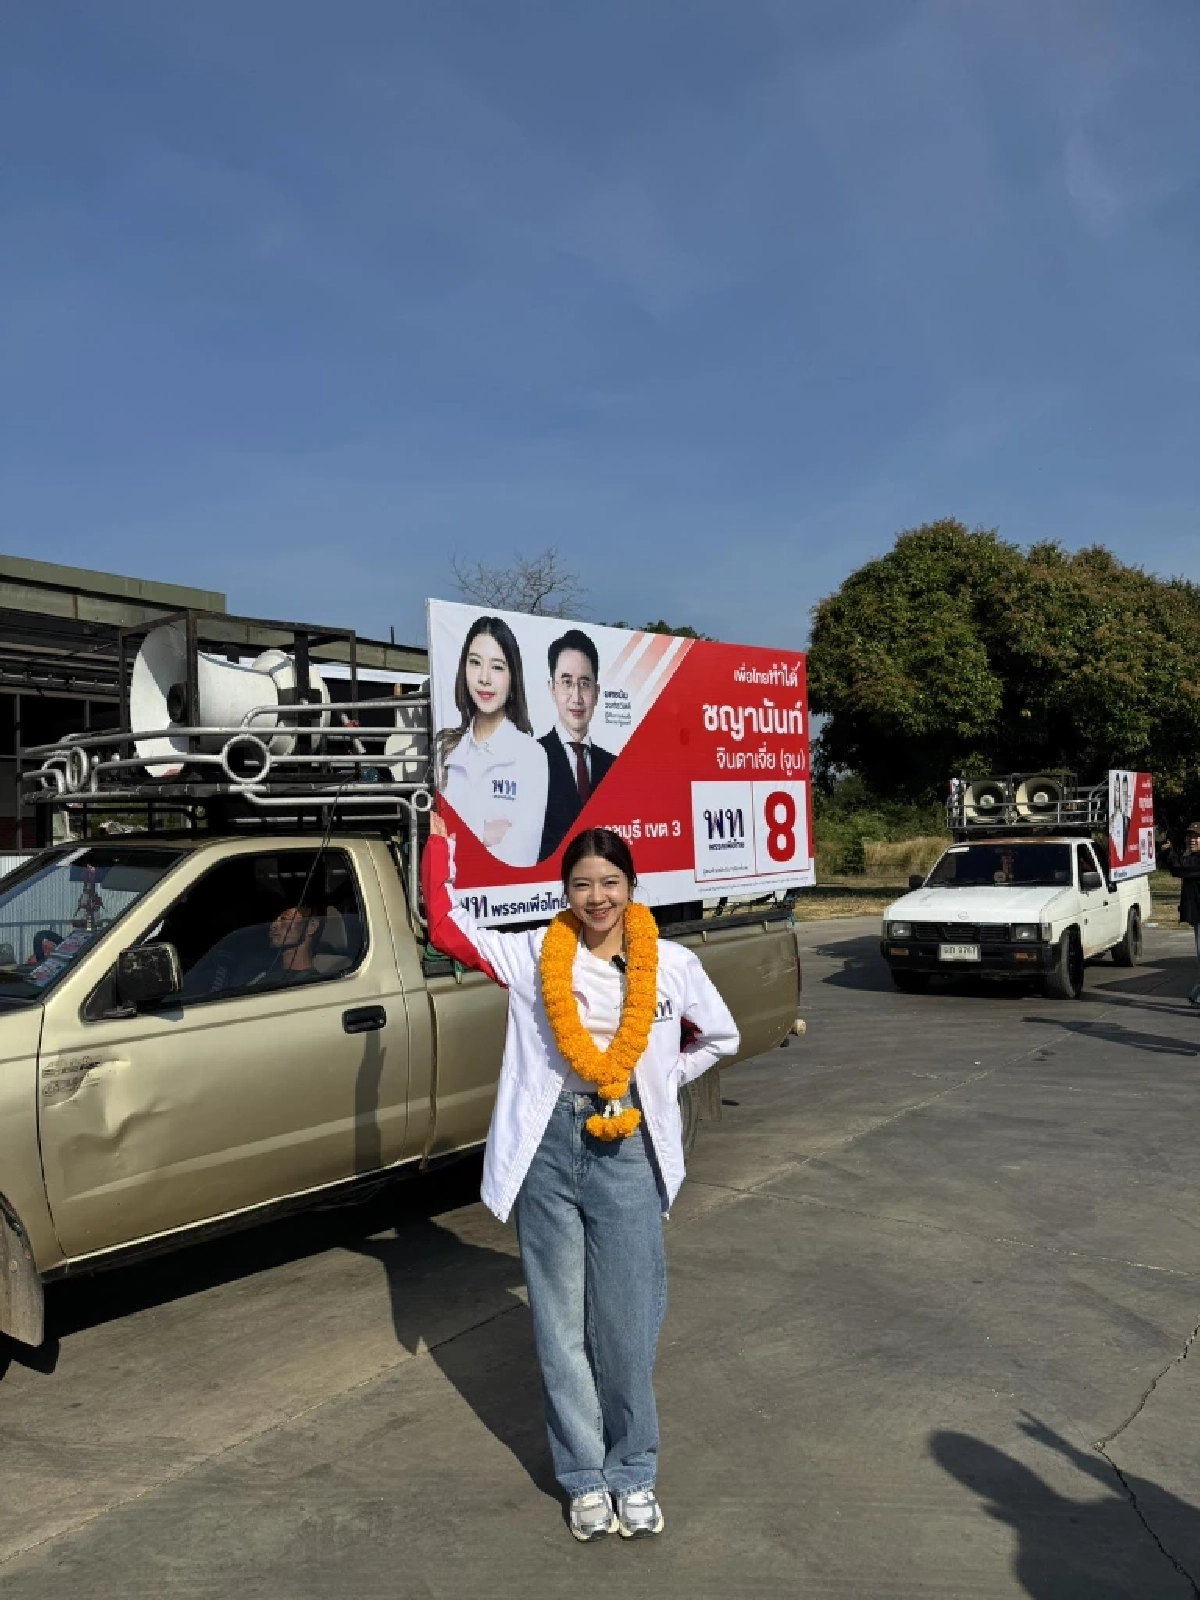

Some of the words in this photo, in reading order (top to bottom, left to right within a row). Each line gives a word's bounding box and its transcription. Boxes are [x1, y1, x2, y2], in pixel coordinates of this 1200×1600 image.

[702, 697, 803, 741] ชญานันท์
[716, 741, 776, 770] จินดาเจี่ย
[644, 822, 670, 838] เขต
[672, 819, 681, 837] 3
[703, 808, 745, 840] พท
[764, 790, 798, 863] 8
